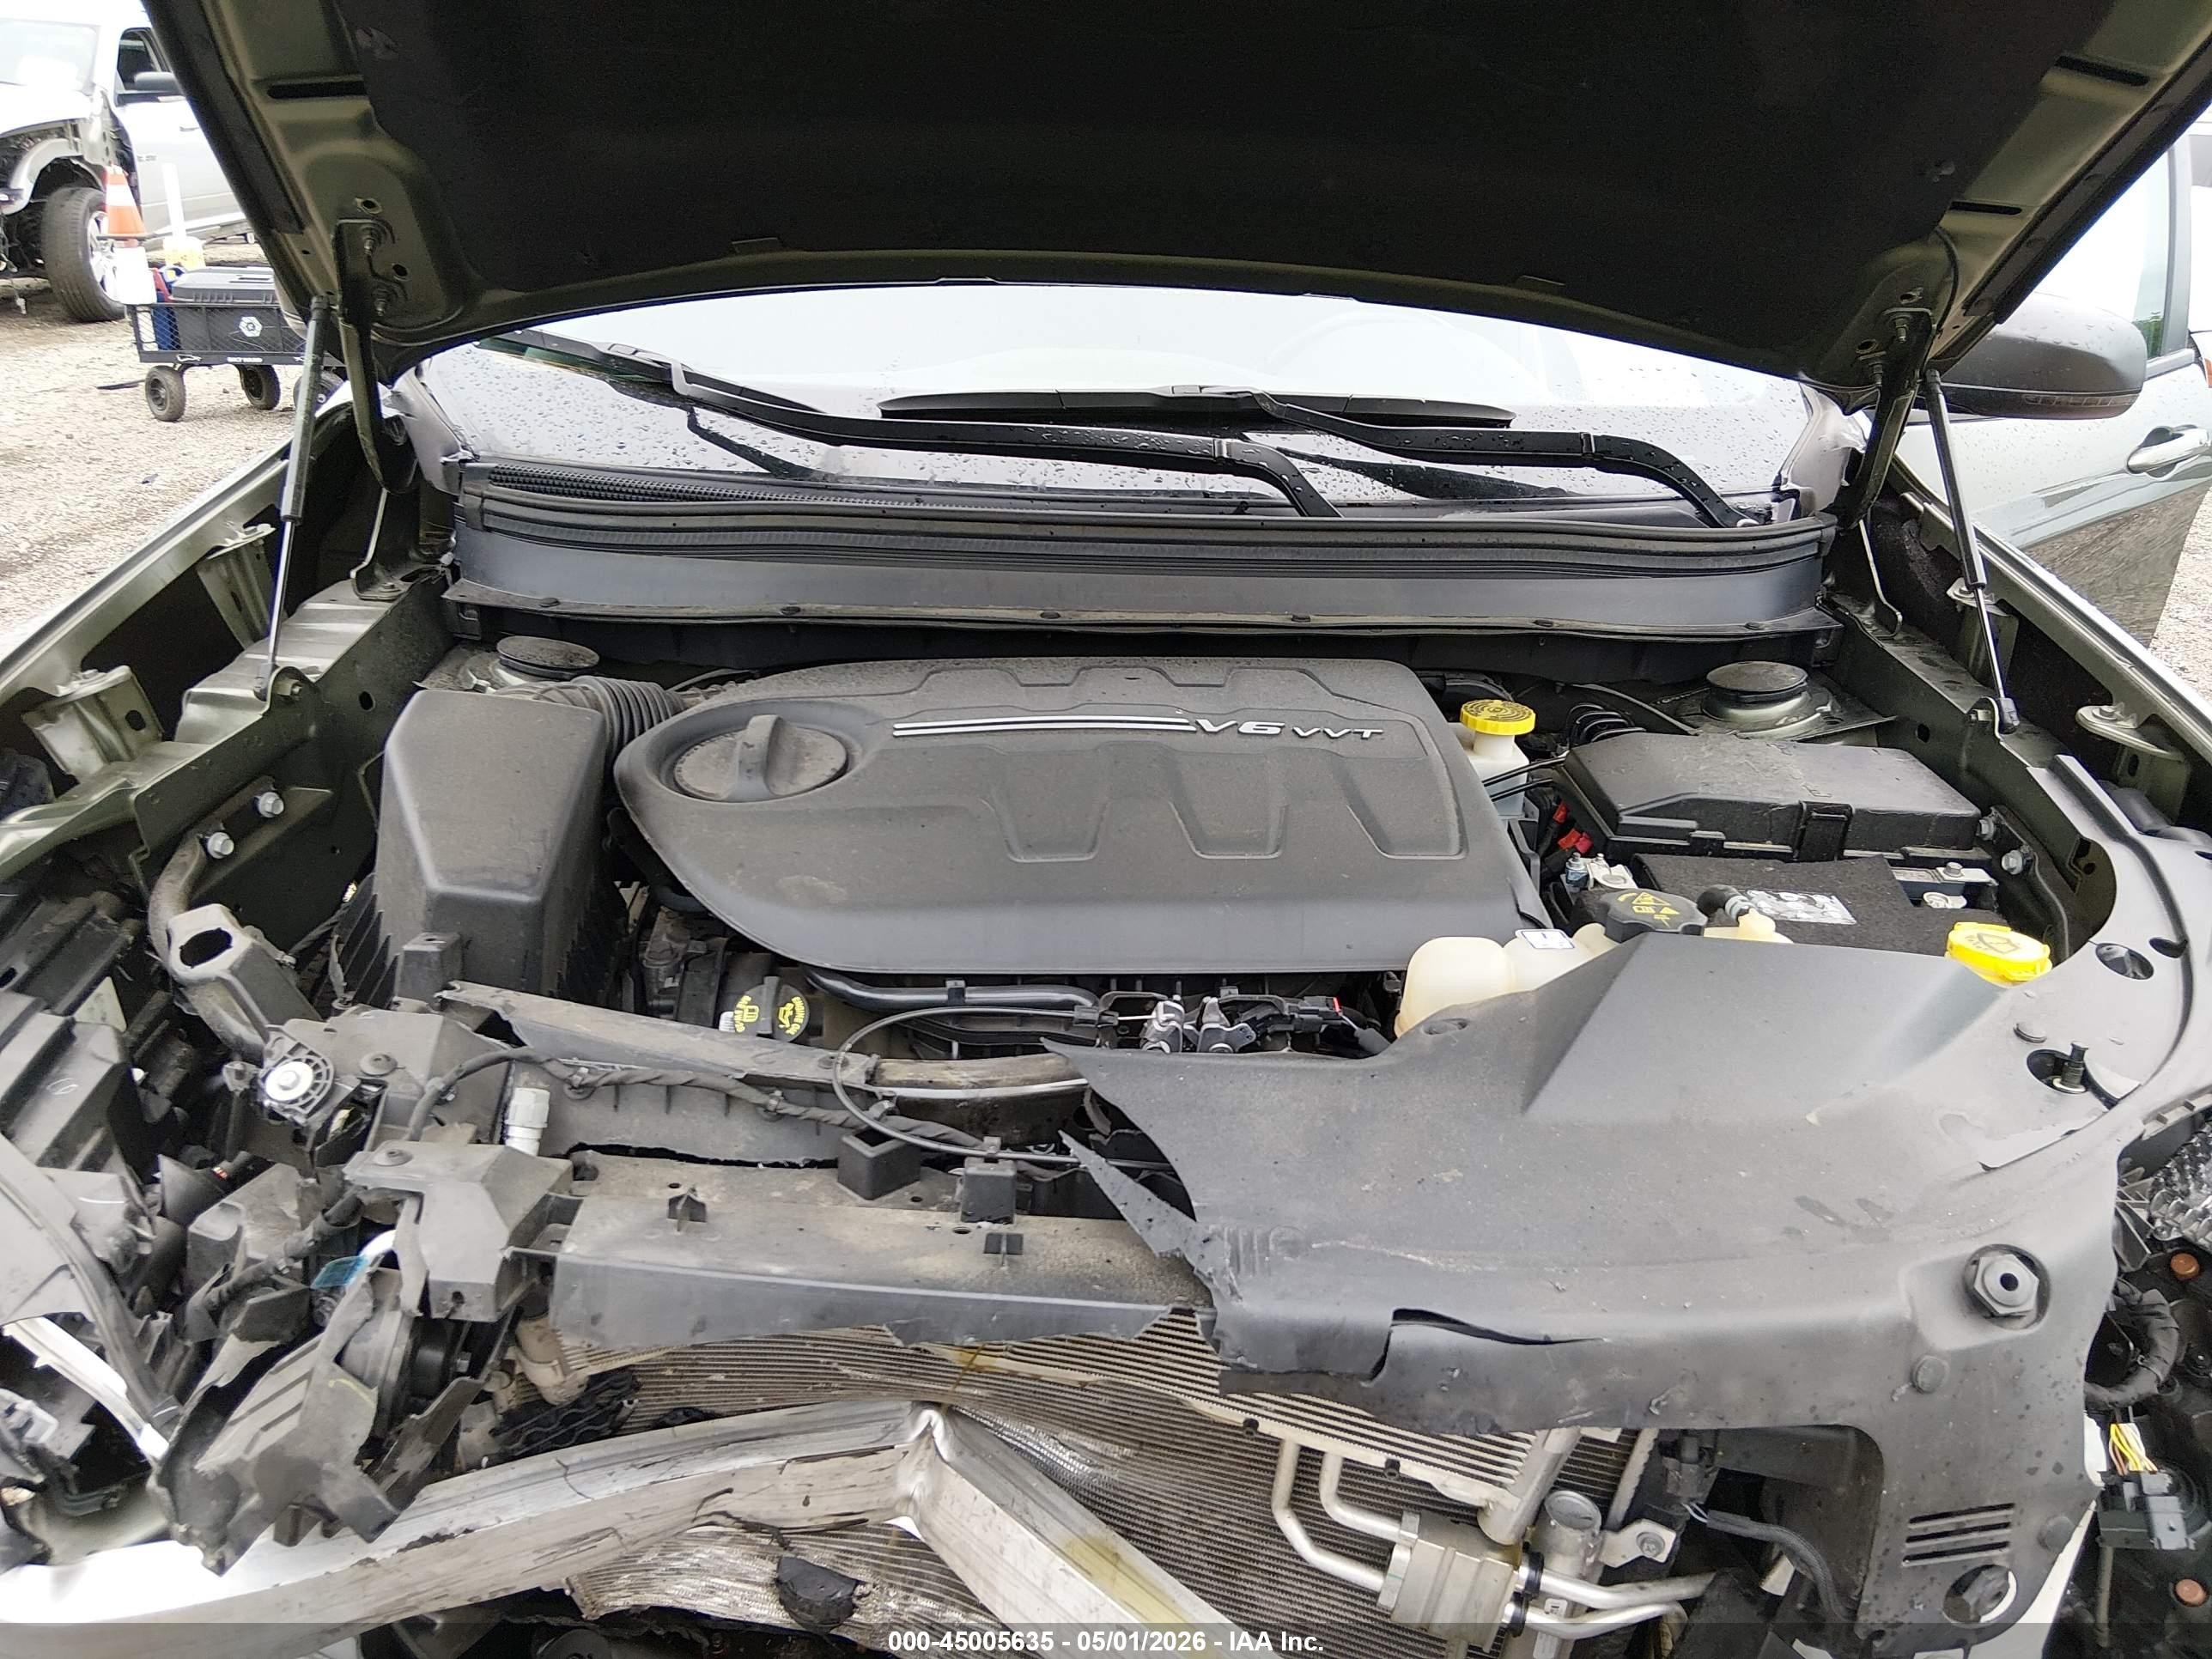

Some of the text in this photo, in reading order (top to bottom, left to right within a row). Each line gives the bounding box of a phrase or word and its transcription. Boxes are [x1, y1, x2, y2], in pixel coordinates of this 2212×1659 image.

[1195, 719, 1384, 739] V6 VVT
[784, 996, 805, 1036] ENGINE OIL
